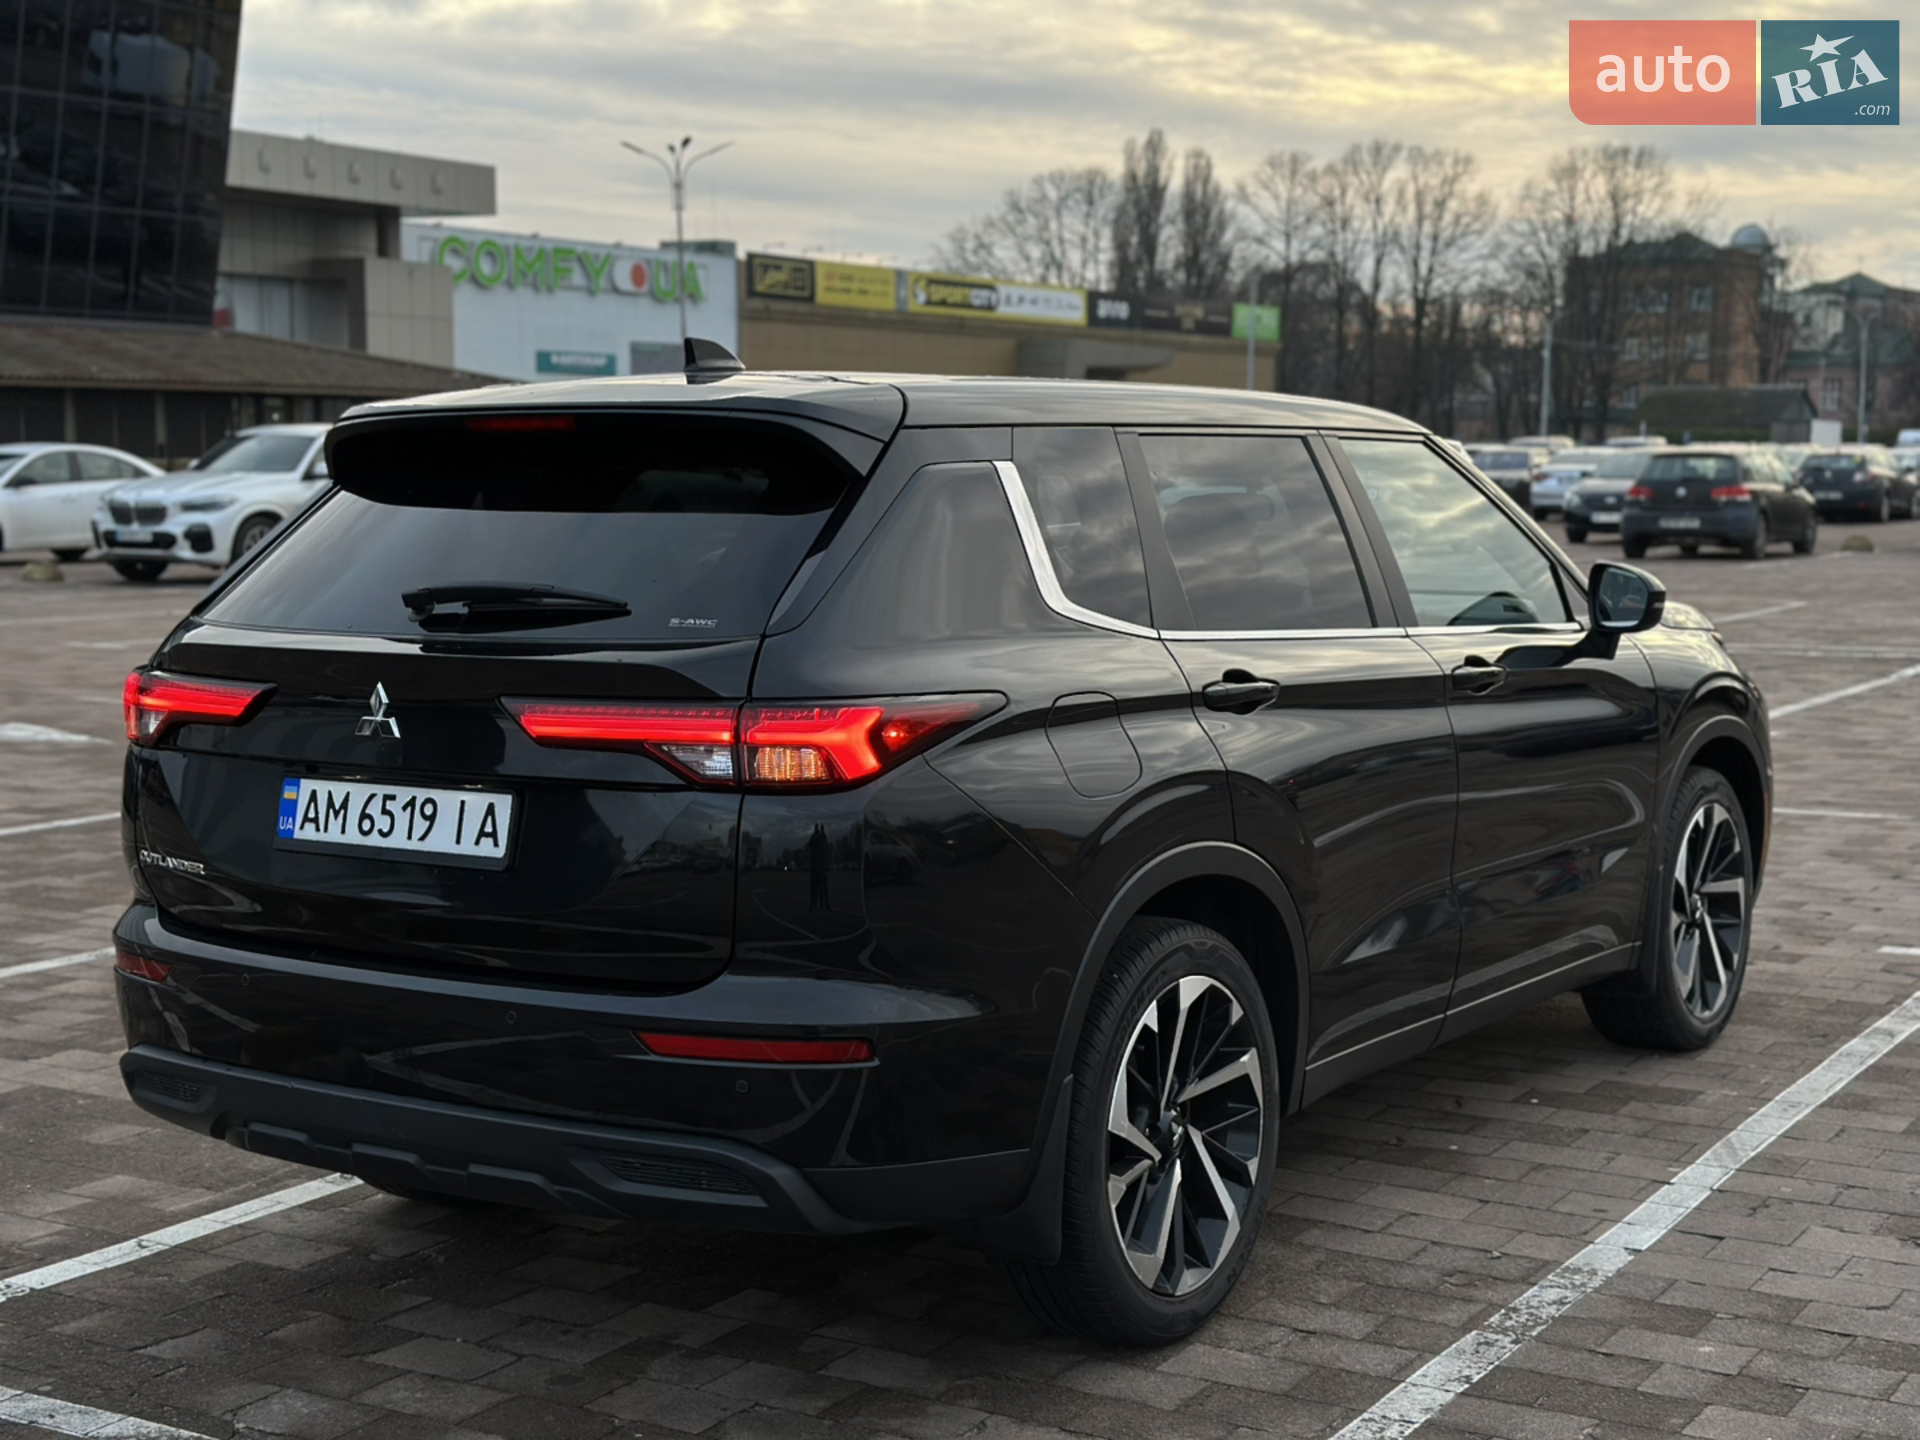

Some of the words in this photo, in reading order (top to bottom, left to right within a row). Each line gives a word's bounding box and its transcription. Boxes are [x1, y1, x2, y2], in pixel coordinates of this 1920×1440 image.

[438, 236, 612, 294] COMFY
[669, 617, 718, 626] S-AWC
[279, 815, 294, 831] UA
[299, 788, 351, 835] AM
[357, 792, 438, 842] 6519
[139, 849, 206, 875] OUTLANDER
